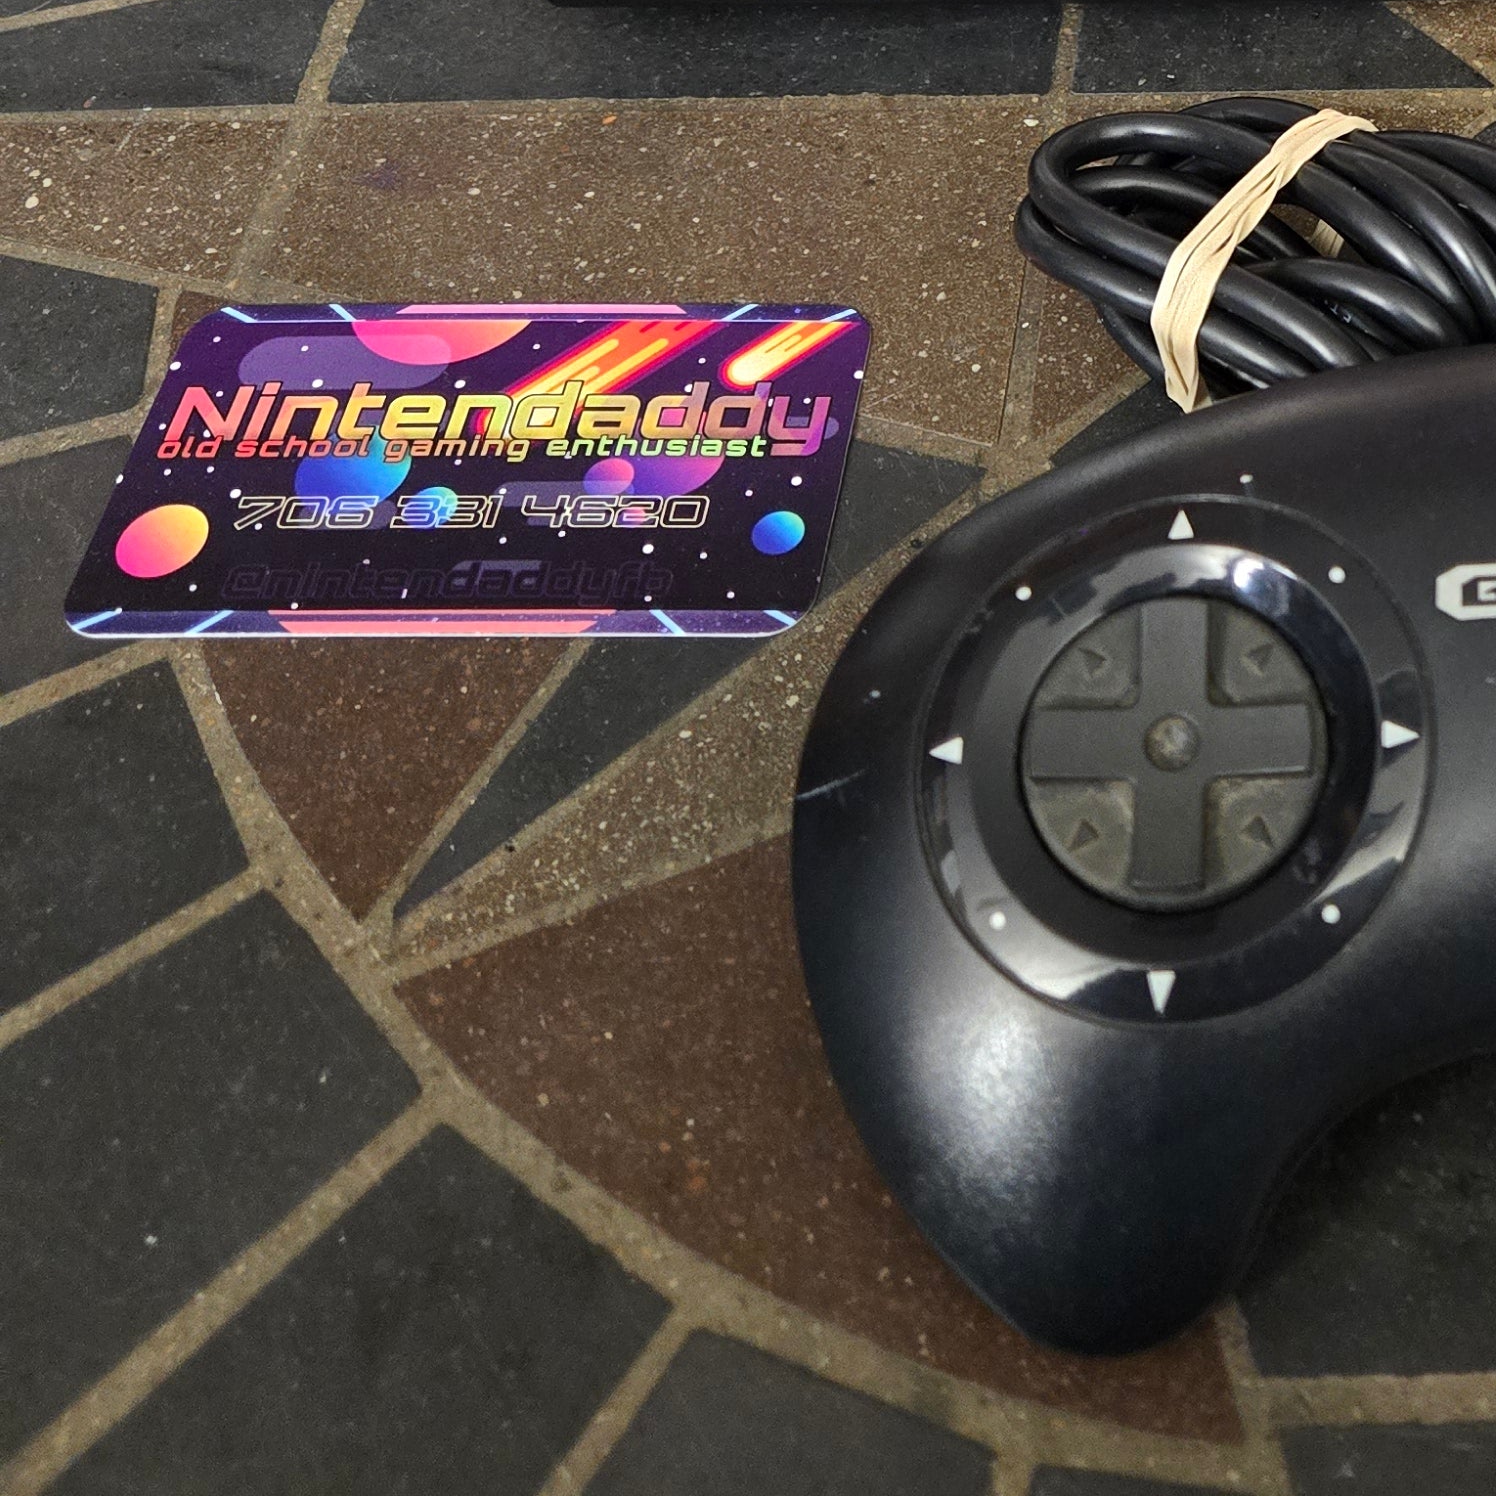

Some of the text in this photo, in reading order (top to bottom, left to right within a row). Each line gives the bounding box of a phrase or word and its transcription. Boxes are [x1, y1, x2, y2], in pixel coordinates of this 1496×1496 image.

[162, 380, 832, 458] Nintendaddy
[156, 433, 768, 464] old school gaming enthusiast
[233, 495, 711, 531] 706 331 4620
